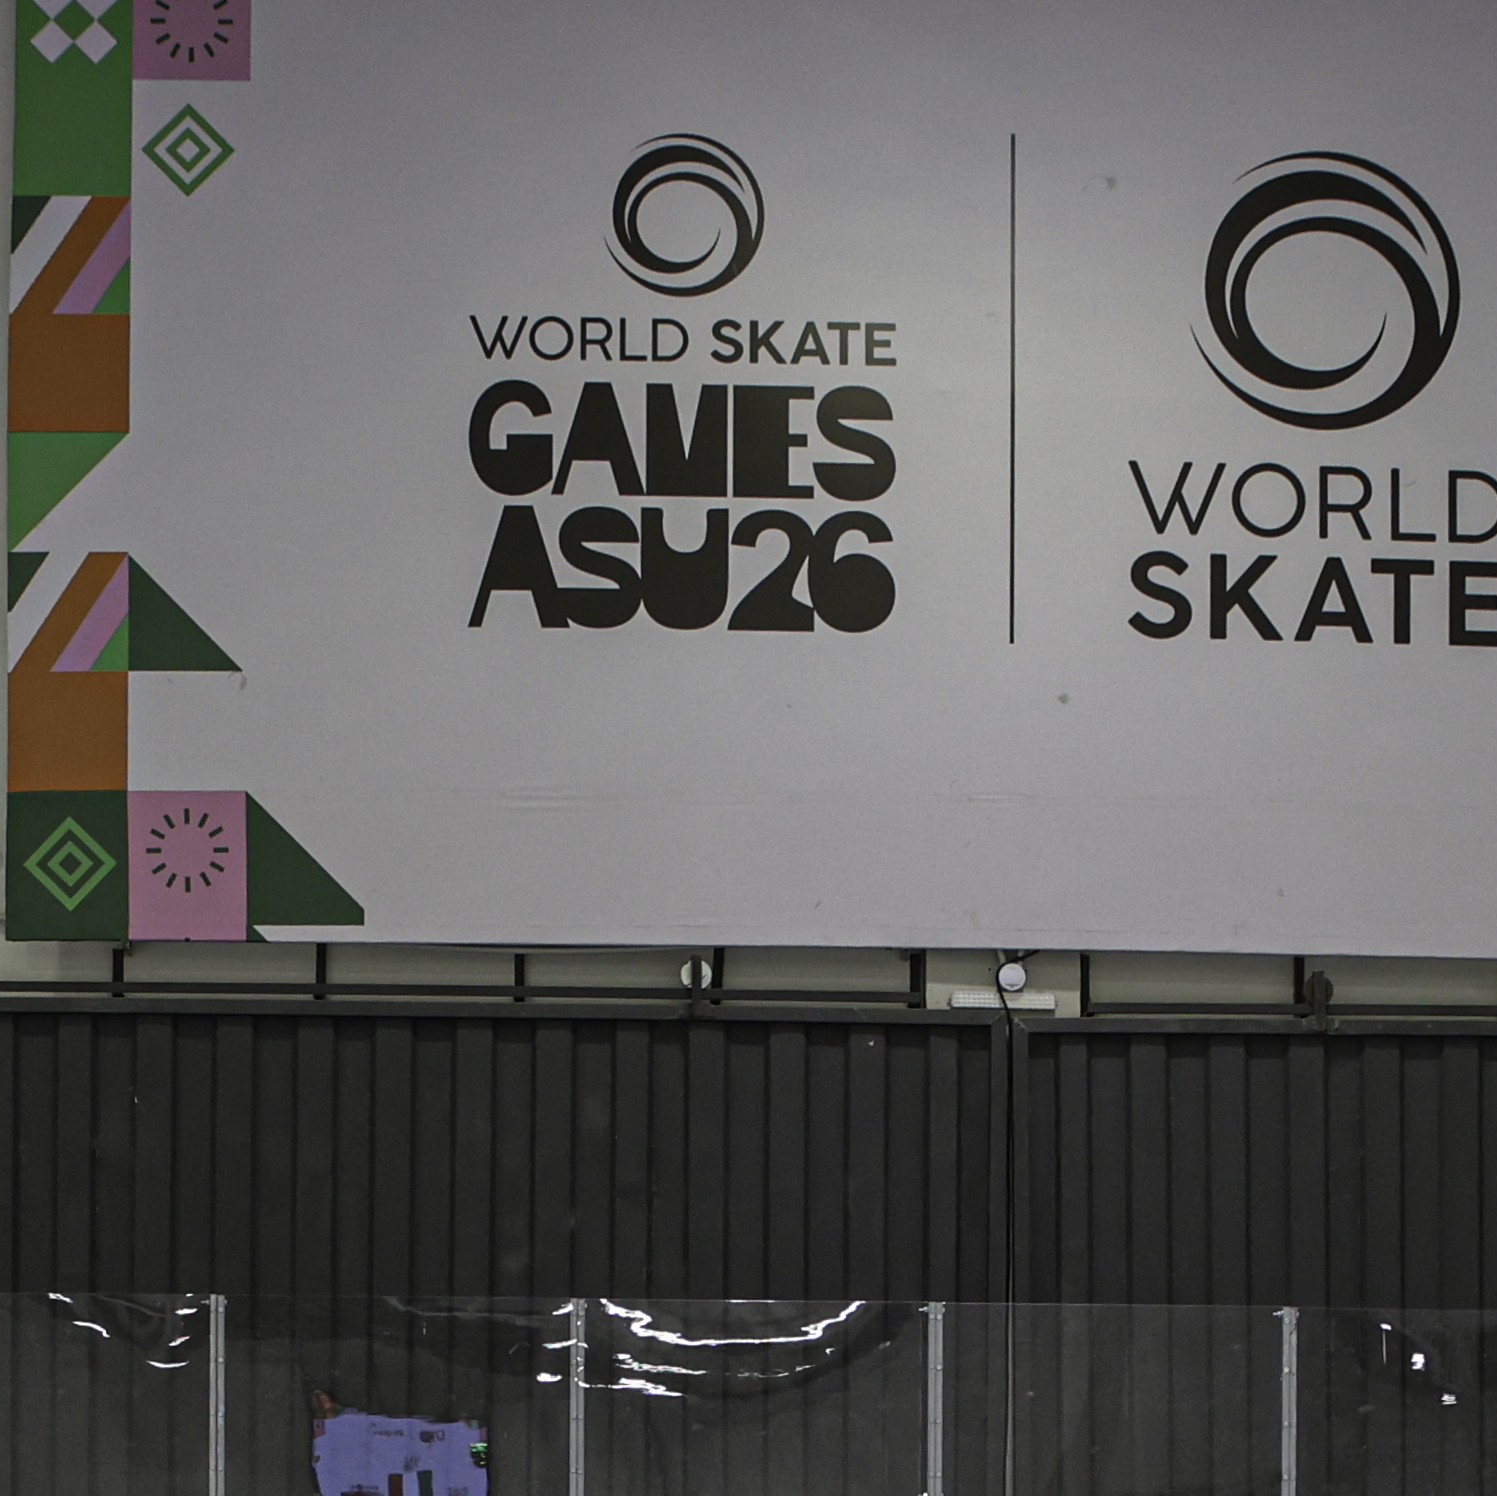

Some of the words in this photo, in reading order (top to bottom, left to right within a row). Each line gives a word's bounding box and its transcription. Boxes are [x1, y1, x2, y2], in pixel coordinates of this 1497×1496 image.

[468, 314, 689, 362] WORLD
[710, 319, 897, 366] SKATE
[468, 379, 896, 501] GAMES
[468, 505, 896, 633] ASU26
